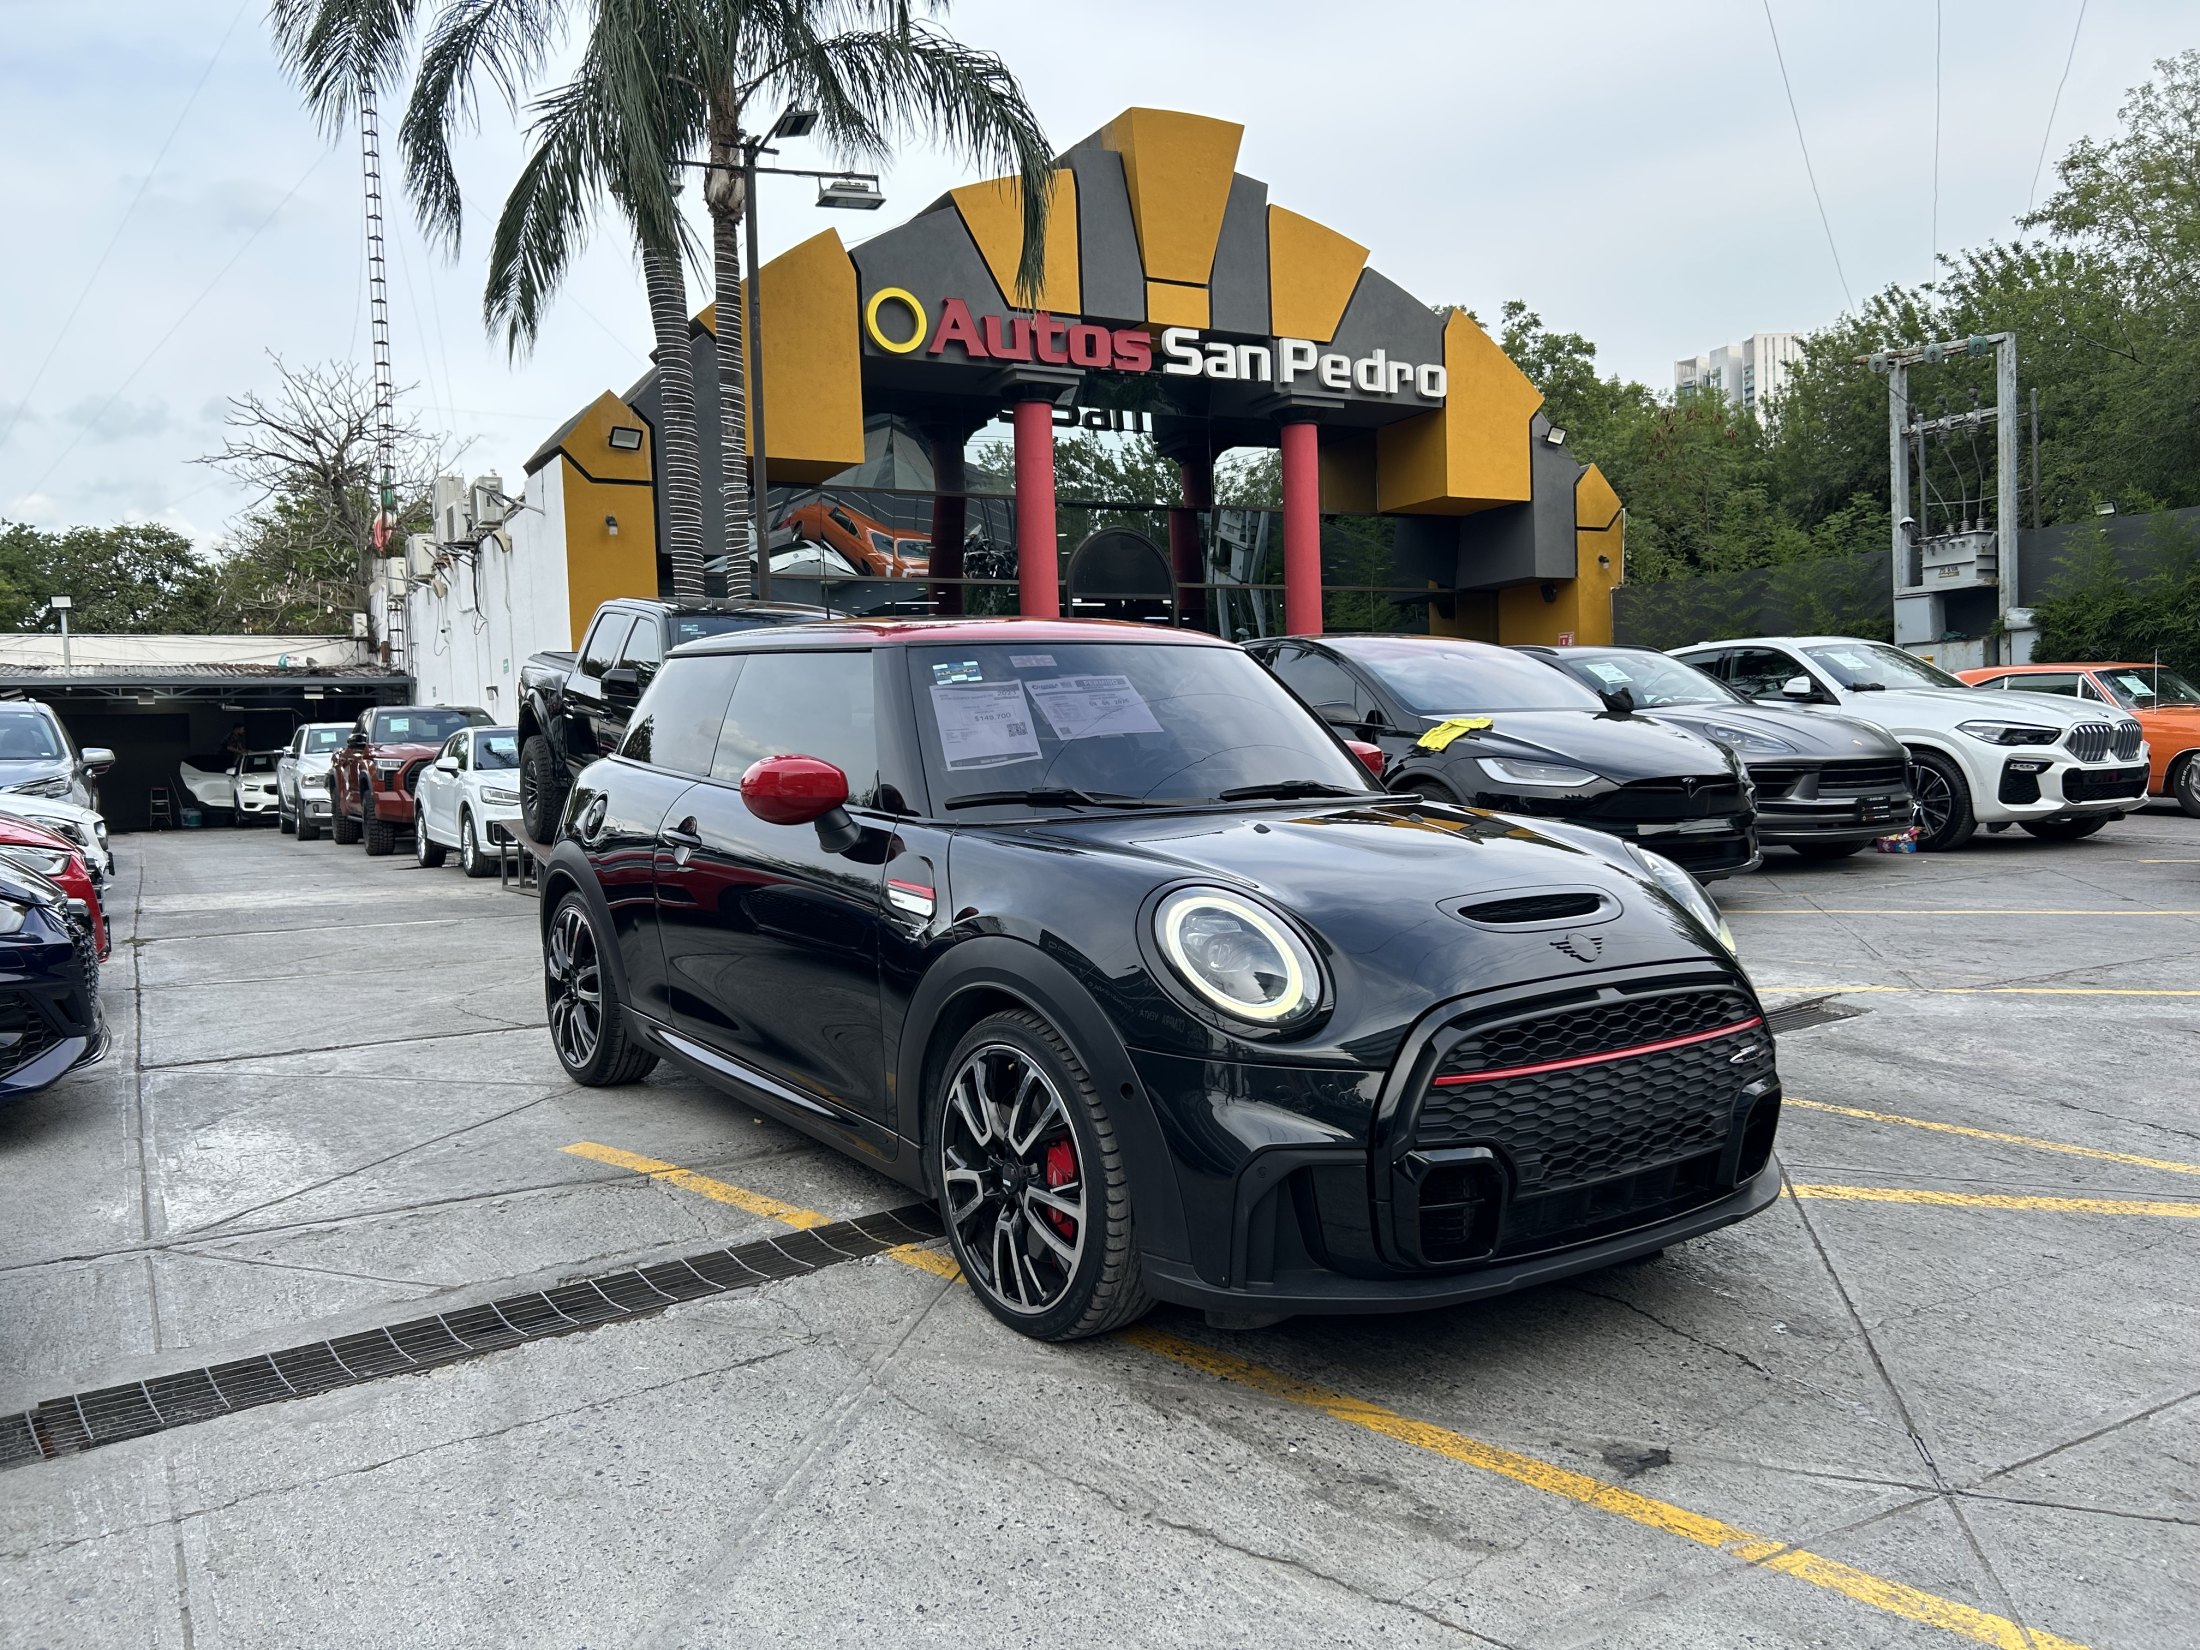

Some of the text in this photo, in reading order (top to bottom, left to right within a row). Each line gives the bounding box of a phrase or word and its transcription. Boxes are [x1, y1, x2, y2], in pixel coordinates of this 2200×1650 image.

[928, 297, 1448, 399] Autos San Pedro
